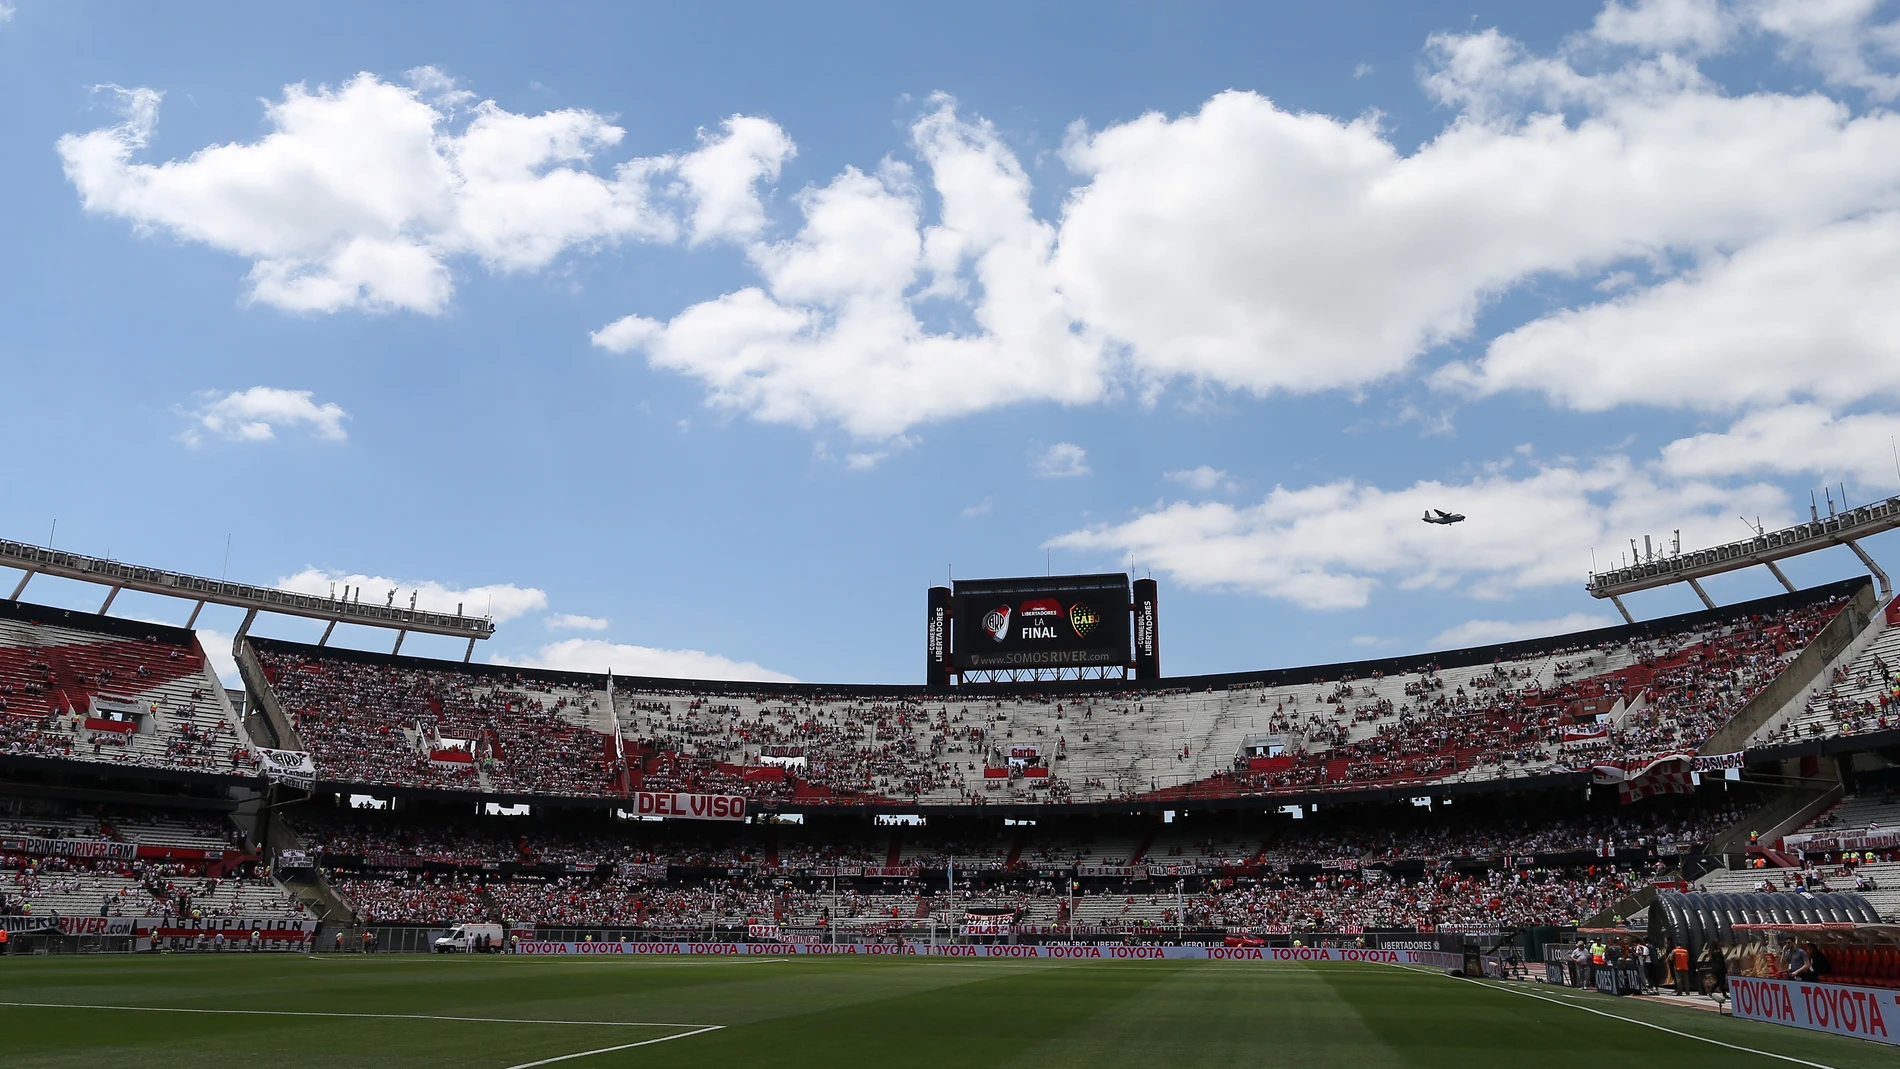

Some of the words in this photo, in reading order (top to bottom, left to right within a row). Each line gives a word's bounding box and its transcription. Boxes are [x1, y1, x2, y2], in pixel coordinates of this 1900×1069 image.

[1034, 618, 1045, 626] LA
[1022, 626, 1058, 639] FINAL
[1144, 600, 1153, 656] LIBERTADORES
[935, 607, 943, 662] LIBERTADORES
[453, 729, 479, 739] GARIN
[1694, 753, 1743, 771] CASILDA
[638, 793, 686, 815] DEL
[691, 795, 745, 818] VISO
[161, 917, 303, 931] AGRUPACION
[750, 925, 778, 937] OZZY
[968, 926, 999, 934] PILAR
[1009, 925, 1037, 934] VILLA
[519, 943, 567, 953] TOYOTA
[575, 943, 624, 953] TOYOTA
[631, 943, 680, 953] TOYOTA
[688, 944, 738, 954] TOYOTA
[746, 944, 797, 954] TOYOTA
[805, 945, 857, 954] TOYOTA
[864, 945, 916, 954] TOYOTA
[1380, 941, 1432, 950] LIBERTADORES
[985, 946, 1038, 957] TOYOTA
[1046, 947, 1101, 957] TOYOTA
[1109, 948, 1165, 958] TOYOTA
[1206, 948, 1263, 959] TOYOTA
[1271, 949, 1330, 960] TOYOTA
[1339, 949, 1399, 962] TOYOTA
[1731, 980, 1796, 1021] TOYOTA
[1800, 986, 1888, 1037] TOYOTA
